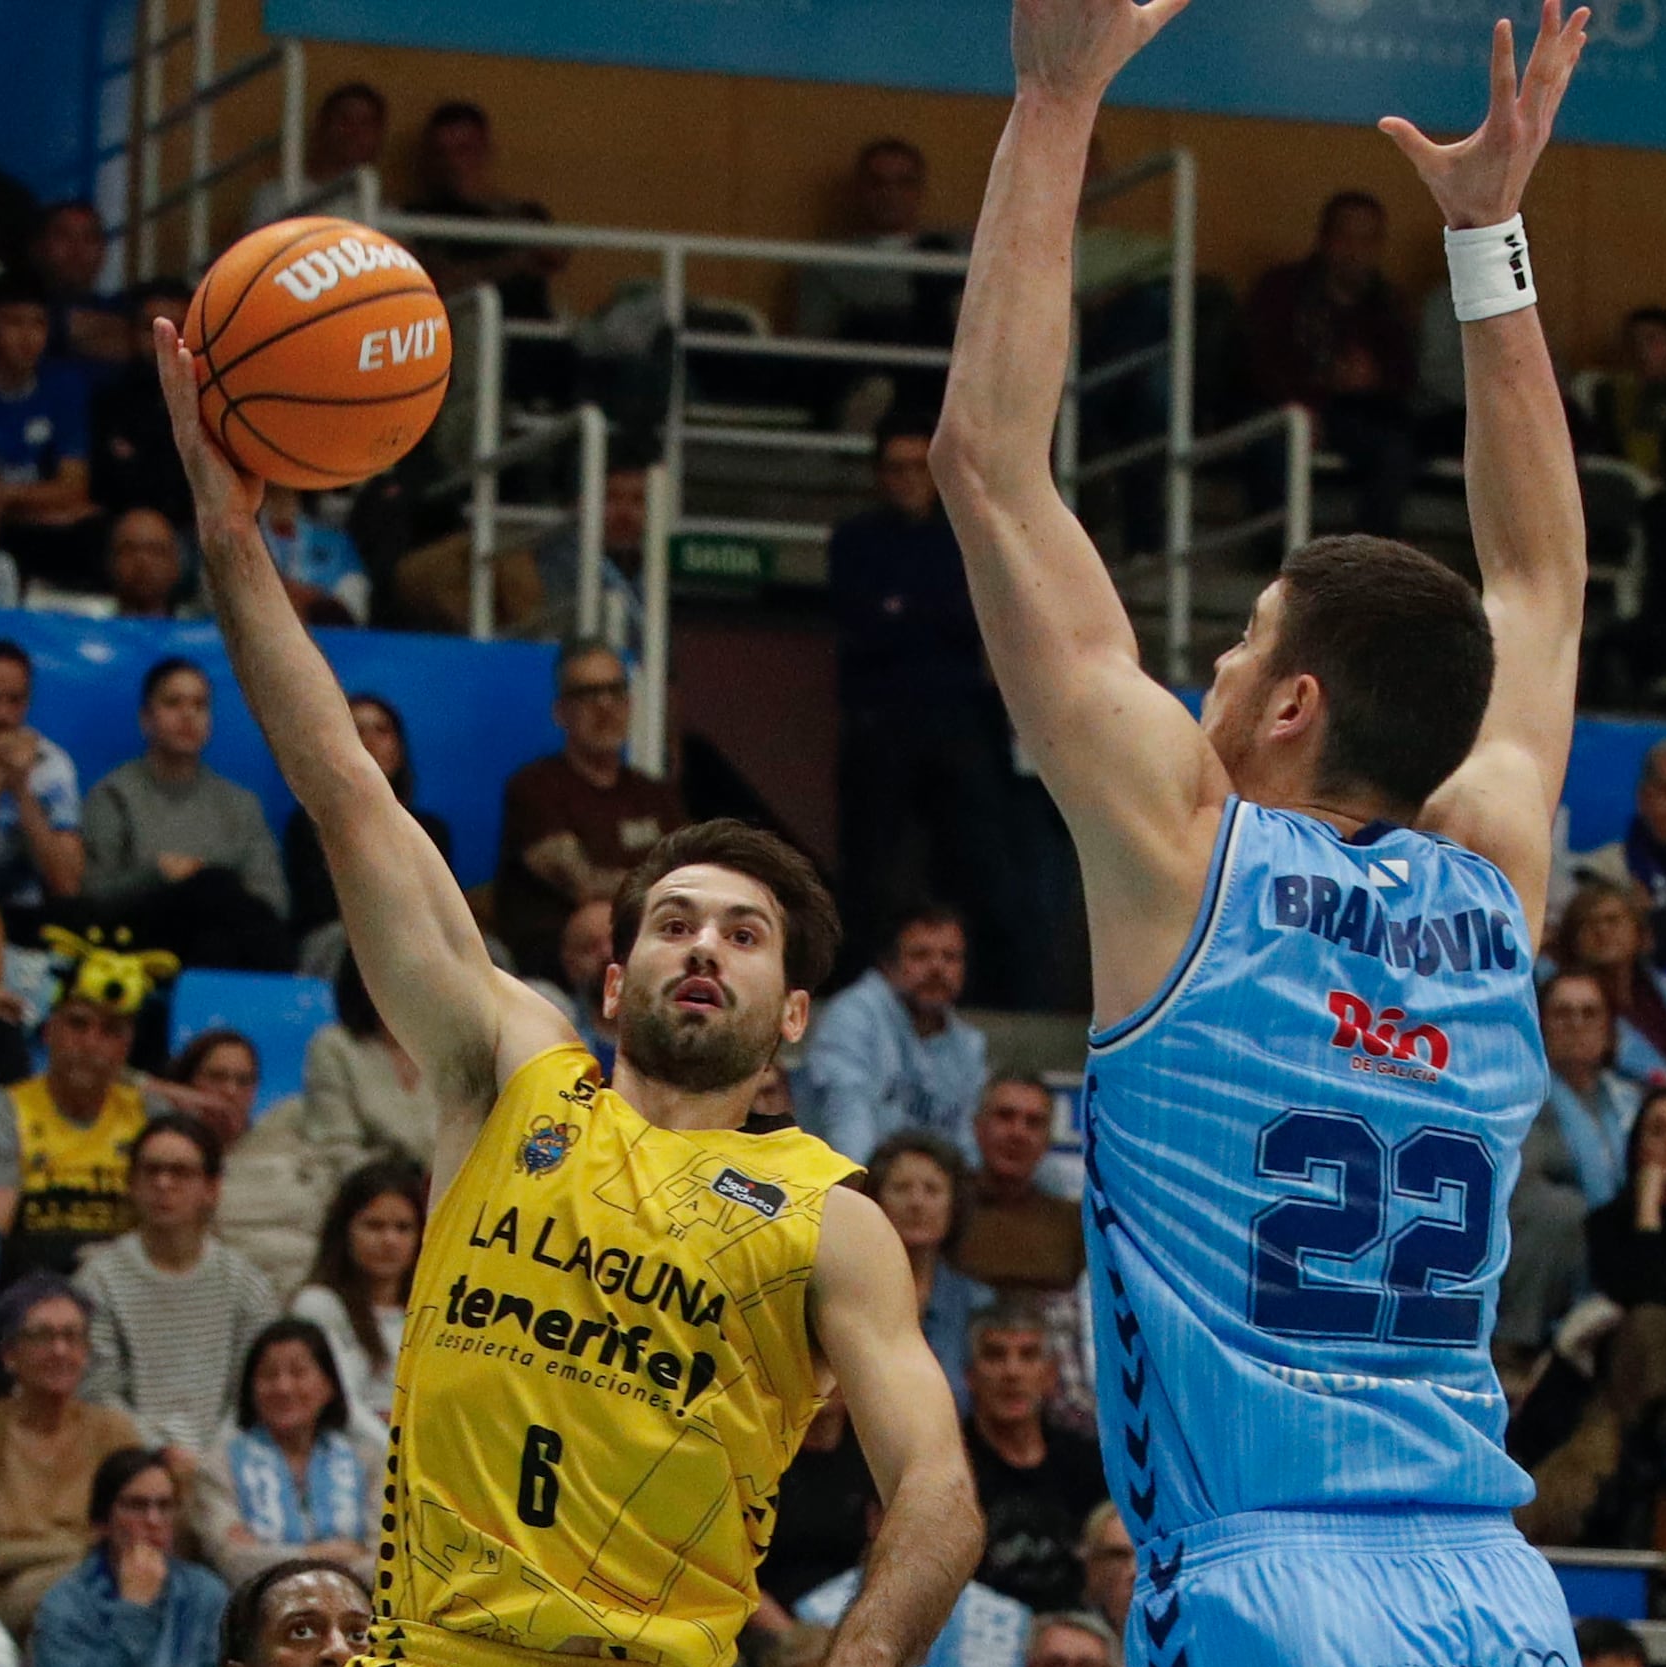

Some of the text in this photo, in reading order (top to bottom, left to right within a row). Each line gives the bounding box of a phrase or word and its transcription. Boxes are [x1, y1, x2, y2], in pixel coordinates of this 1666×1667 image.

[1351, 1056, 1438, 1083] DE GALICIA
[470, 1201, 726, 1338] LA LAGUNA
[1248, 1107, 1496, 1348] 22
[436, 1330, 534, 1367] despierta
[517, 1424, 563, 1529] 6
